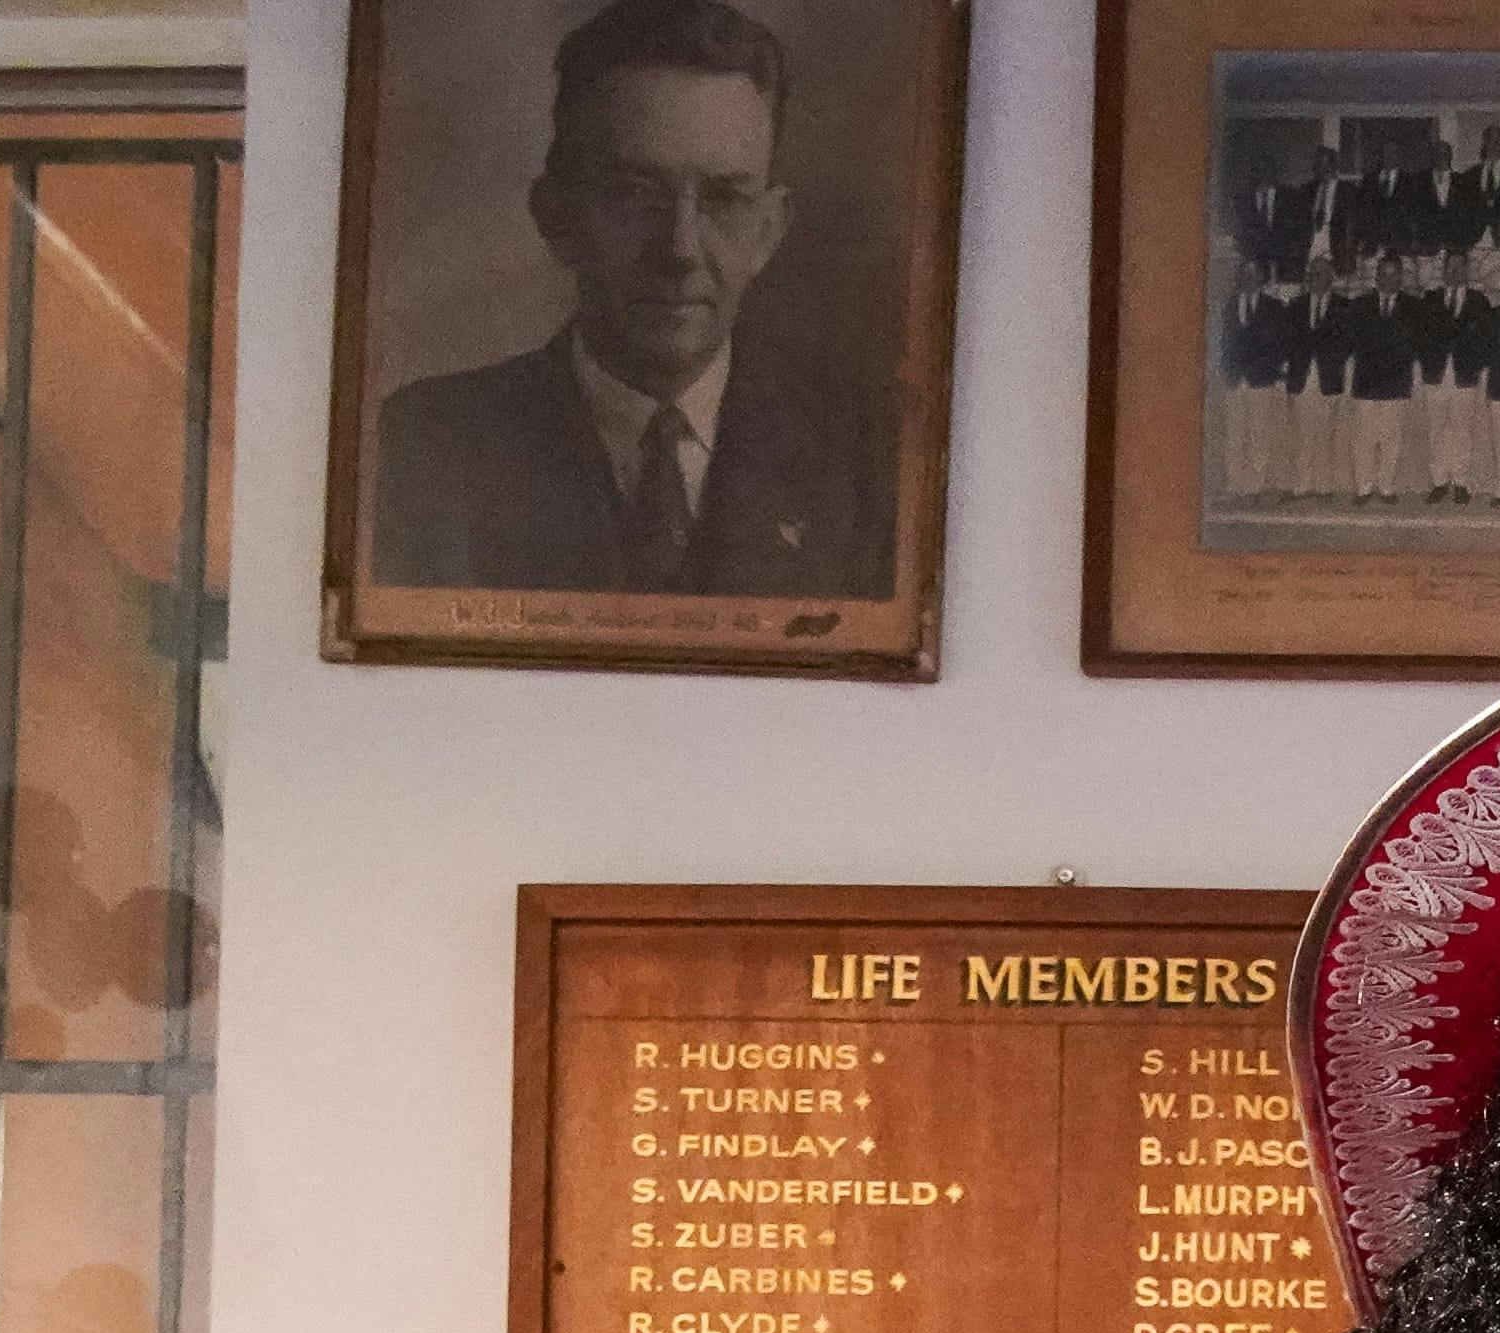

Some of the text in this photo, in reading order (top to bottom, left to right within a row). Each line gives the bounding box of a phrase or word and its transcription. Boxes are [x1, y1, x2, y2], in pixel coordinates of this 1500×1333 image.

[811, 954, 1277, 1005] LIFE MEMBERS
[635, 1042, 858, 1071] R. HUGGINS
[1139, 1048, 1280, 1076] S. HILL
[633, 1087, 844, 1114] S. TURNER
[631, 1133, 847, 1158] G. FINDLAY
[632, 1177, 938, 1205] S. VANDERFIELD
[631, 1223, 807, 1249] S. ZUBER
[629, 1266, 875, 1296] R. CARBINES
